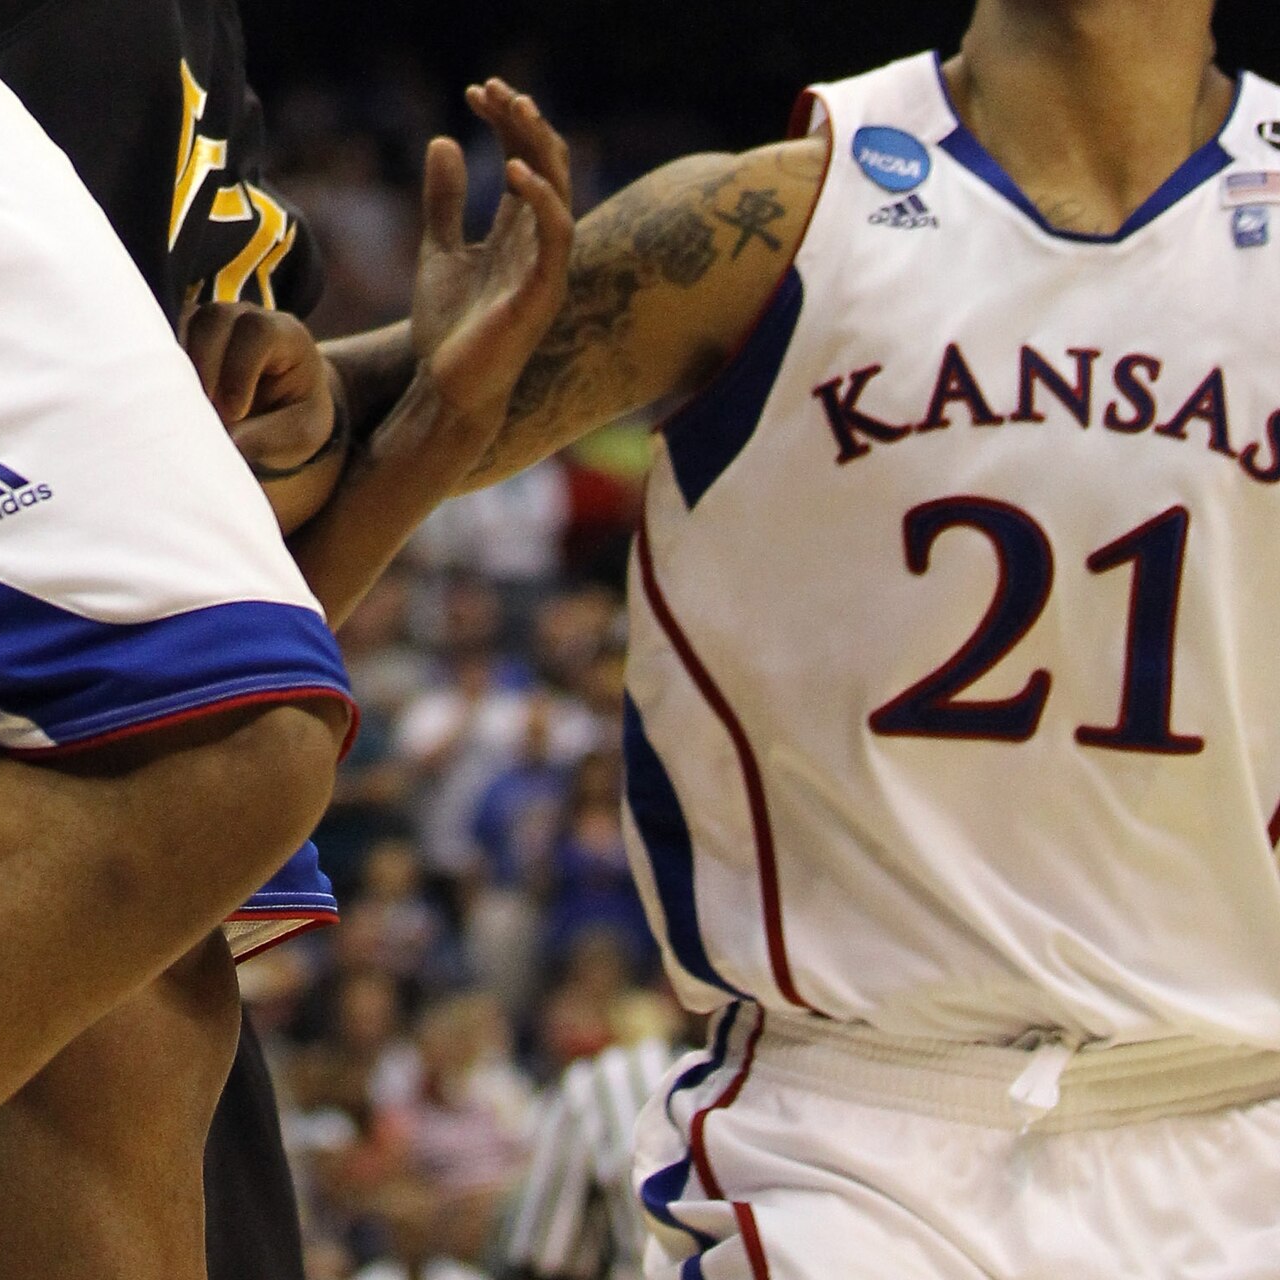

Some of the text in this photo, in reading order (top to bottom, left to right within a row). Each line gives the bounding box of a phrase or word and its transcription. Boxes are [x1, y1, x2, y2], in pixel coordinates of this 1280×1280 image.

[859, 146, 921, 180] NCAA
[812, 342, 1280, 484] KANSAS
[867, 494, 1205, 755] 21
